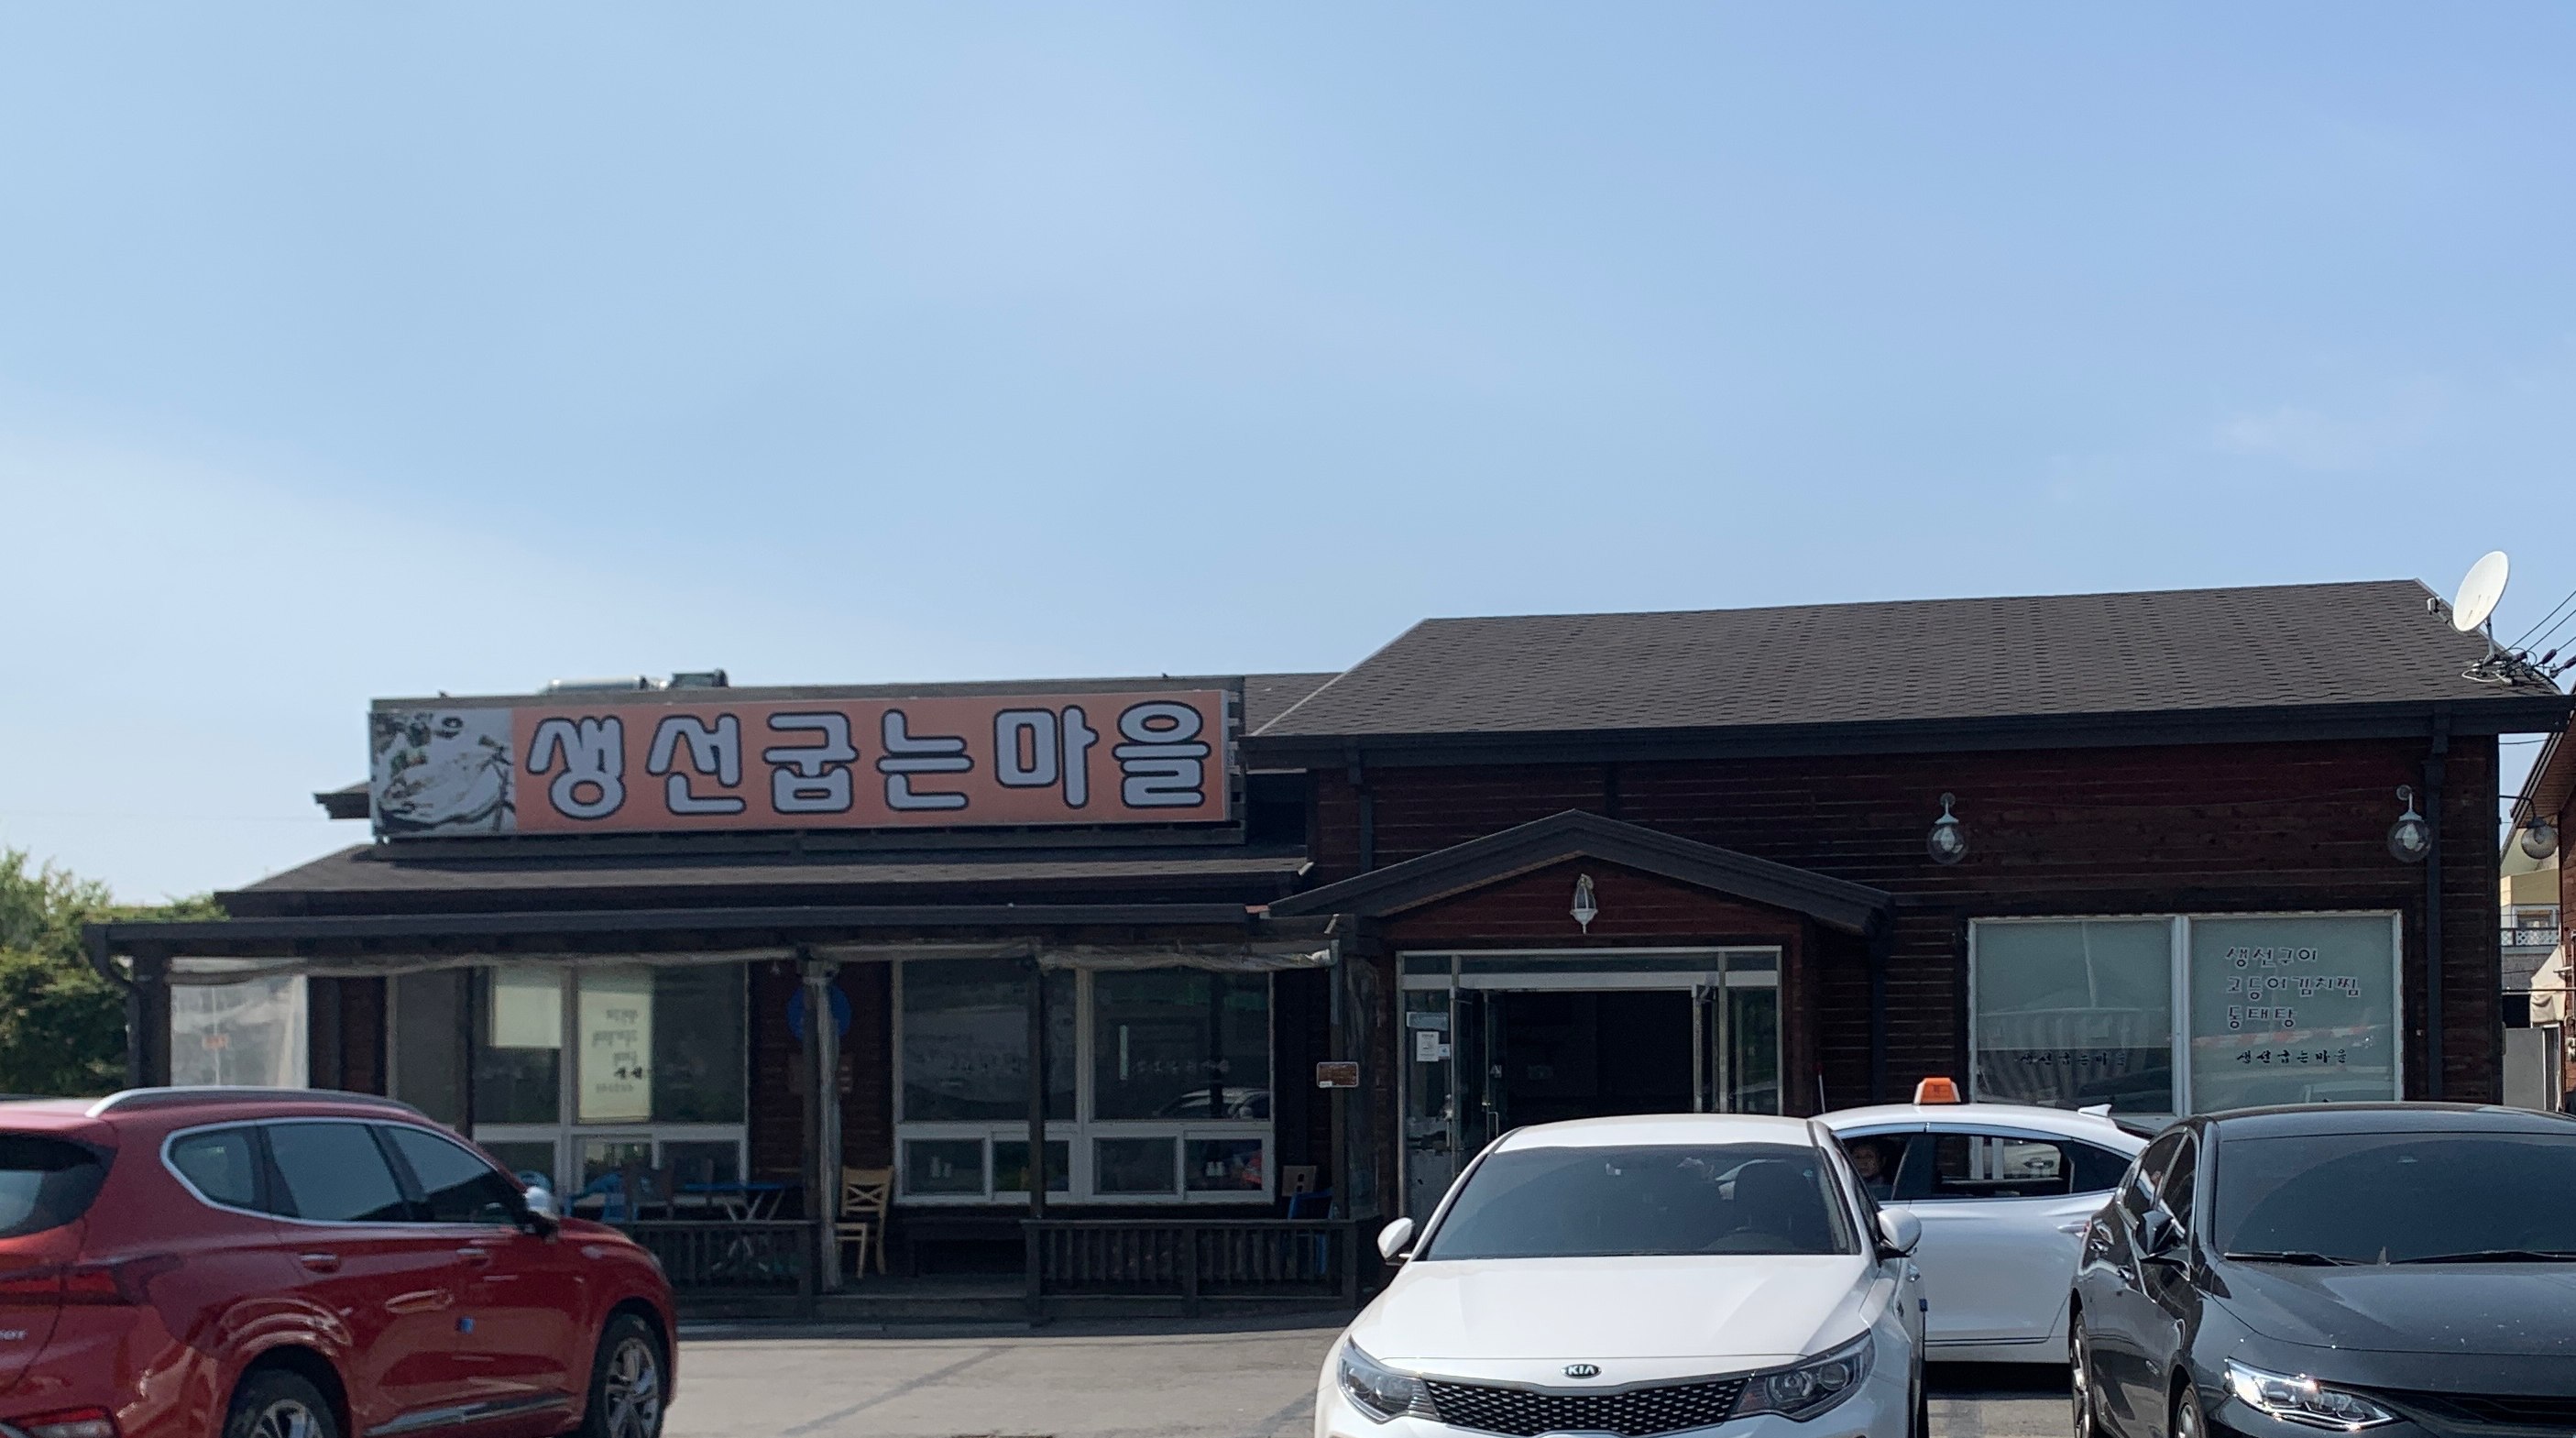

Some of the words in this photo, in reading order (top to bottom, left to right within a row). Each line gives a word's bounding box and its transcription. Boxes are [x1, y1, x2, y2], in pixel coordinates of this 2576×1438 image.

[525, 700, 1211, 818] 생선굽는마을
[2225, 946, 2318, 969] 생선구이
[2227, 975, 2361, 1001] 고등어김치찜
[2227, 1004, 2297, 1029] 동태탕
[1568, 1365, 1595, 1375] KIA
